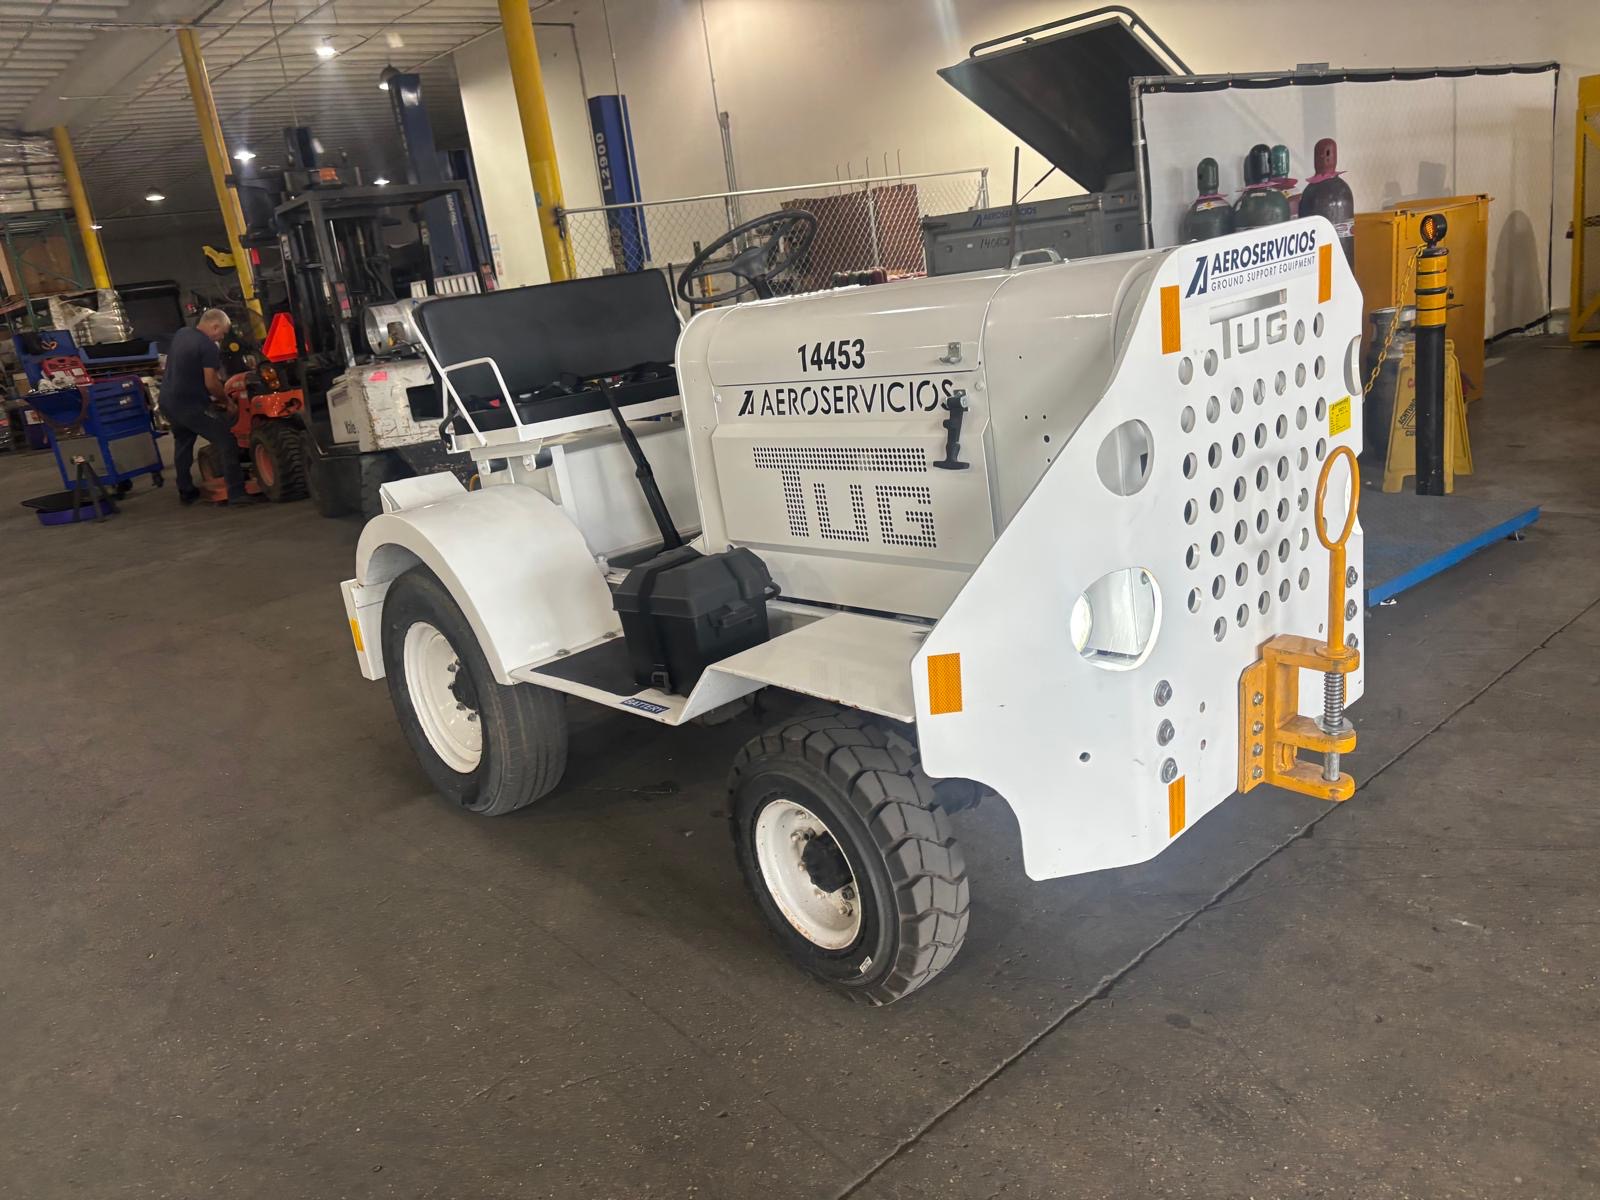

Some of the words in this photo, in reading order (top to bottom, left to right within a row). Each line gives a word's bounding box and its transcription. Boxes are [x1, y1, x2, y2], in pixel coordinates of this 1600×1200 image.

[596, 132, 613, 191] L2900
[1211, 229, 1316, 275] AEROSERVICIOS
[1211, 277, 1244, 292] GROUND
[1247, 265, 1277, 282] SUPPORT
[1279, 256, 1315, 274] EQUIPMENT
[1209, 288, 1287, 360] TUG
[797, 339, 866, 372] 14453
[761, 379, 953, 416] AEROSERVICIOS
[752, 447, 938, 548] TUG
[623, 699, 666, 713] BATTERY
